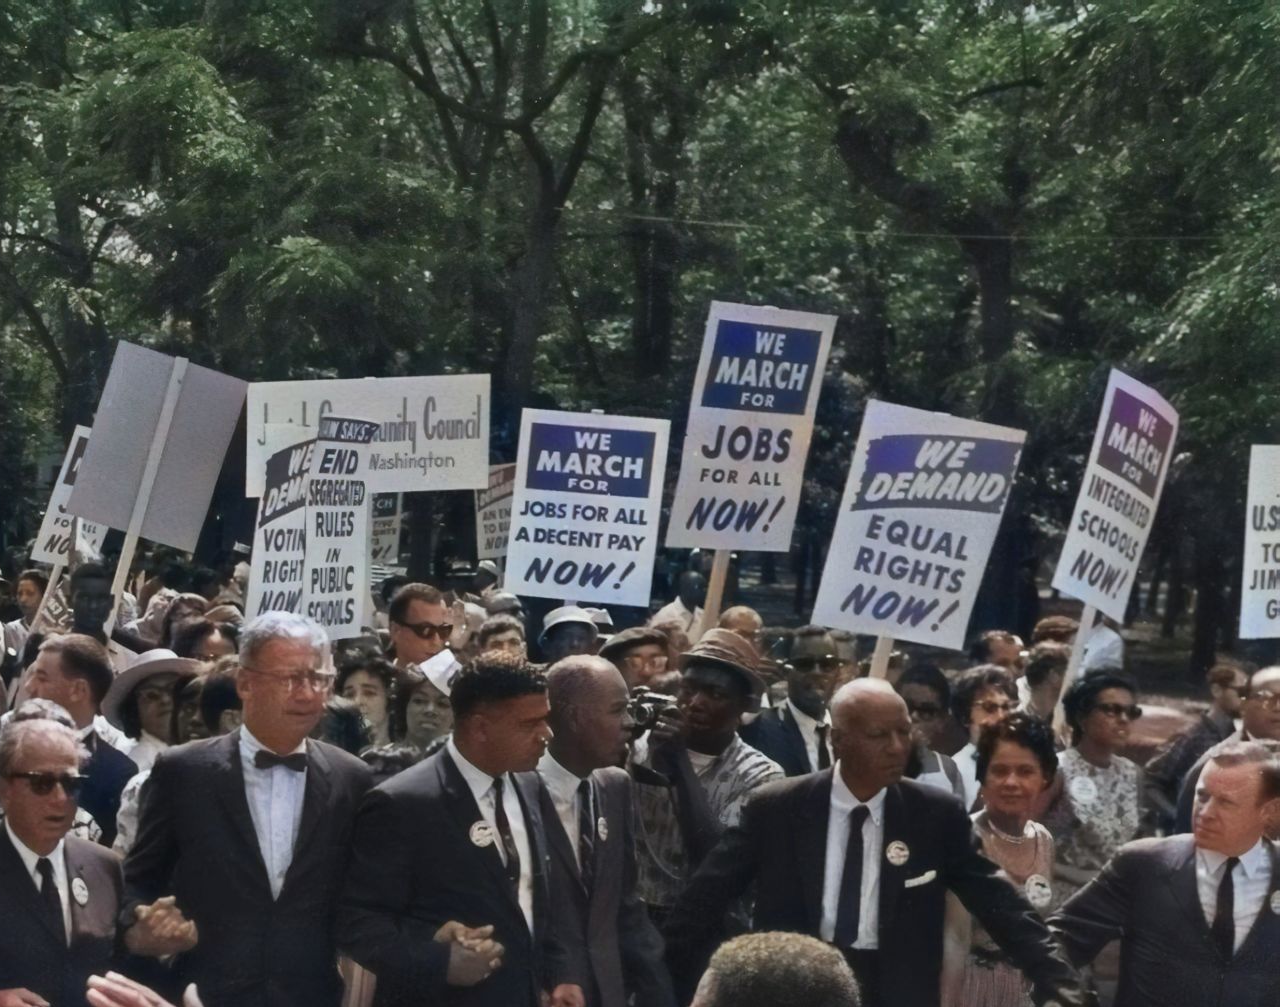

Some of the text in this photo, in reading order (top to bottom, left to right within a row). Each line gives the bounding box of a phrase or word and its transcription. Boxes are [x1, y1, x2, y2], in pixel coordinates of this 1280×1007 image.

[755, 330, 786, 355] WE
[714, 356, 808, 391] MARCH
[740, 392, 775, 408] FOR
[423, 394, 481, 440] Council
[1138, 407, 1159, 437] WE
[574, 431, 612, 451] WE
[701, 425, 793, 463] JOBS
[914, 438, 976, 469] WE
[1107, 422, 1162, 477] MARCH
[319, 448, 359, 475] END
[536, 450, 644, 479] MARCH
[1121, 464, 1142, 486] FOR
[568, 477, 608, 492] FOR
[699, 468, 782, 487] FOR ALL
[864, 471, 1006, 502] DEMAND
[308, 479, 366, 506] SEGREGATED
[1087, 474, 1151, 530] INTEGRATED
[315, 511, 355, 538] RULES
[519, 501, 647, 526] JOBS FOR ALL
[685, 496, 786, 533] NOW!
[515, 527, 646, 552] A DECENT PAY
[866, 514, 968, 561] EQUAL
[1078, 510, 1140, 563] SCHOOLS
[325, 548, 341, 563] IN
[853, 546, 966, 594] RIGHTS
[311, 565, 354, 594] PUBLIC
[524, 556, 636, 590] NOW!
[1070, 549, 1129, 601] NOW!
[308, 598, 355, 627] SCHOOLS
[840, 583, 960, 633] NOW!
